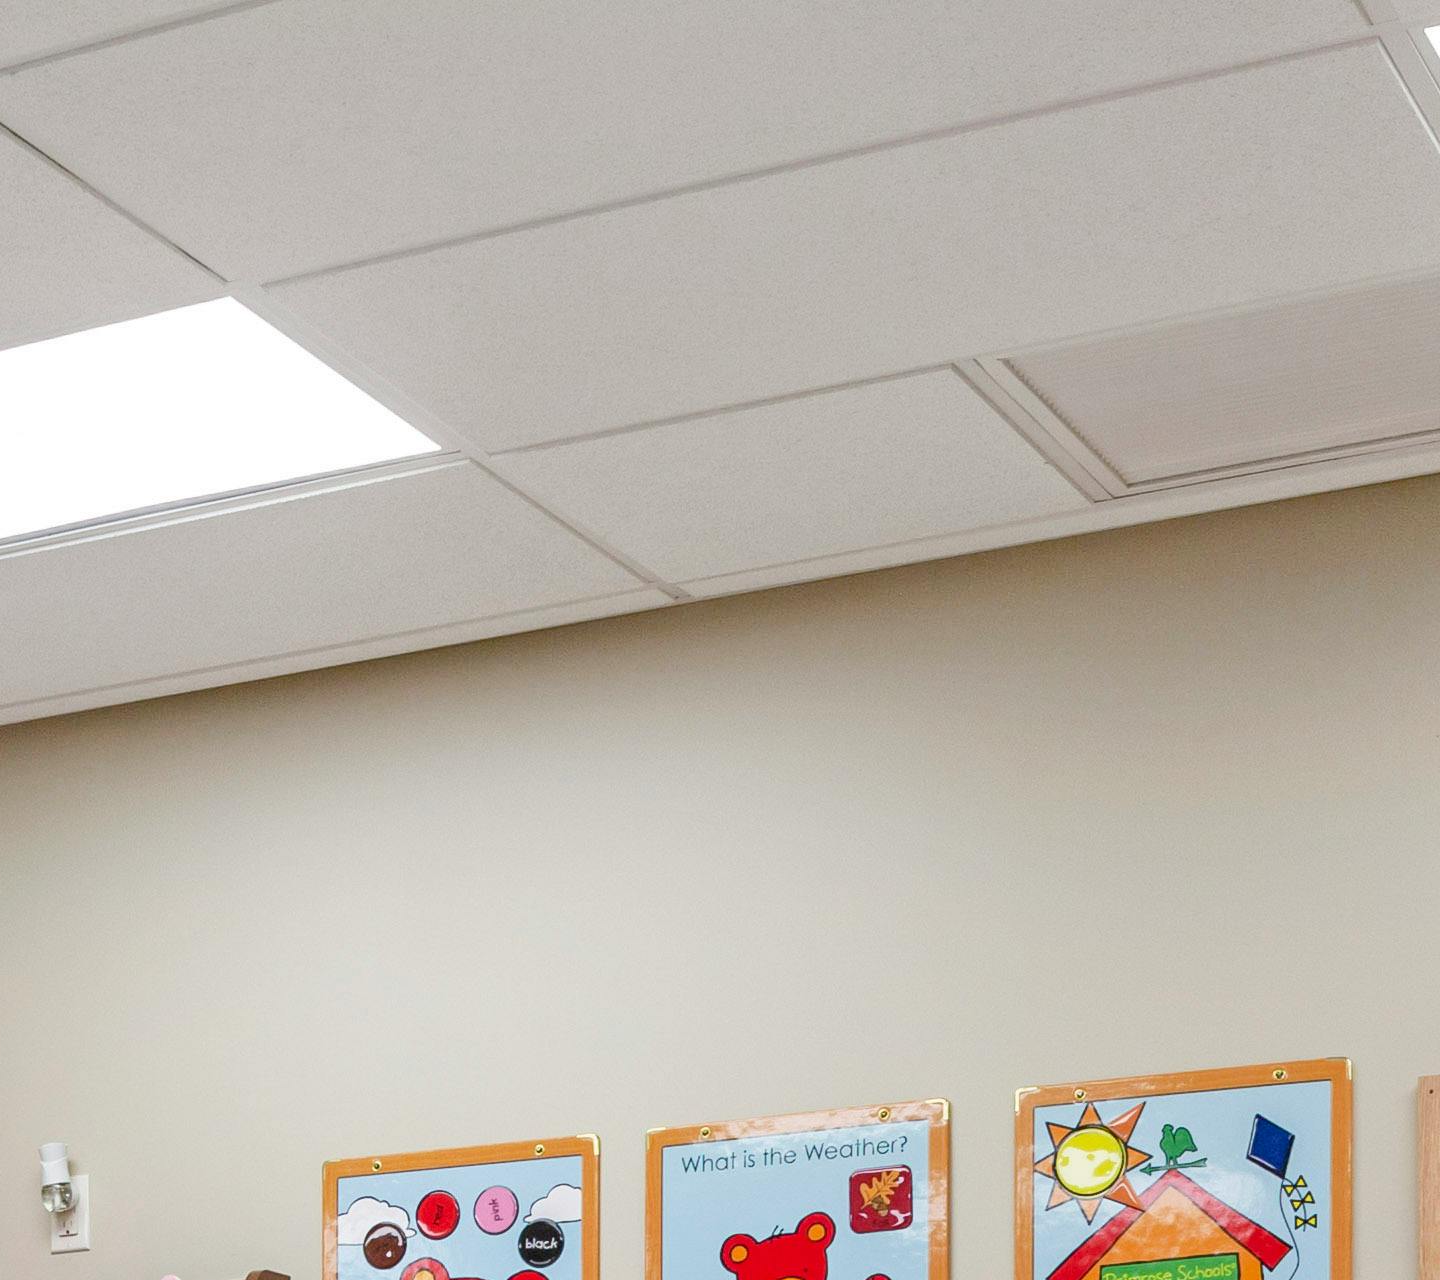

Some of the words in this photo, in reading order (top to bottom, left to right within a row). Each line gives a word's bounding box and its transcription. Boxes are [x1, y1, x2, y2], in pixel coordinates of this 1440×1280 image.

[682, 1148, 735, 1174] What
[744, 1149, 756, 1168] is
[763, 1146, 797, 1165] the
[804, 1136, 908, 1161] Weather?
[488, 1199, 503, 1222] pink
[526, 1239, 558, 1249] black
